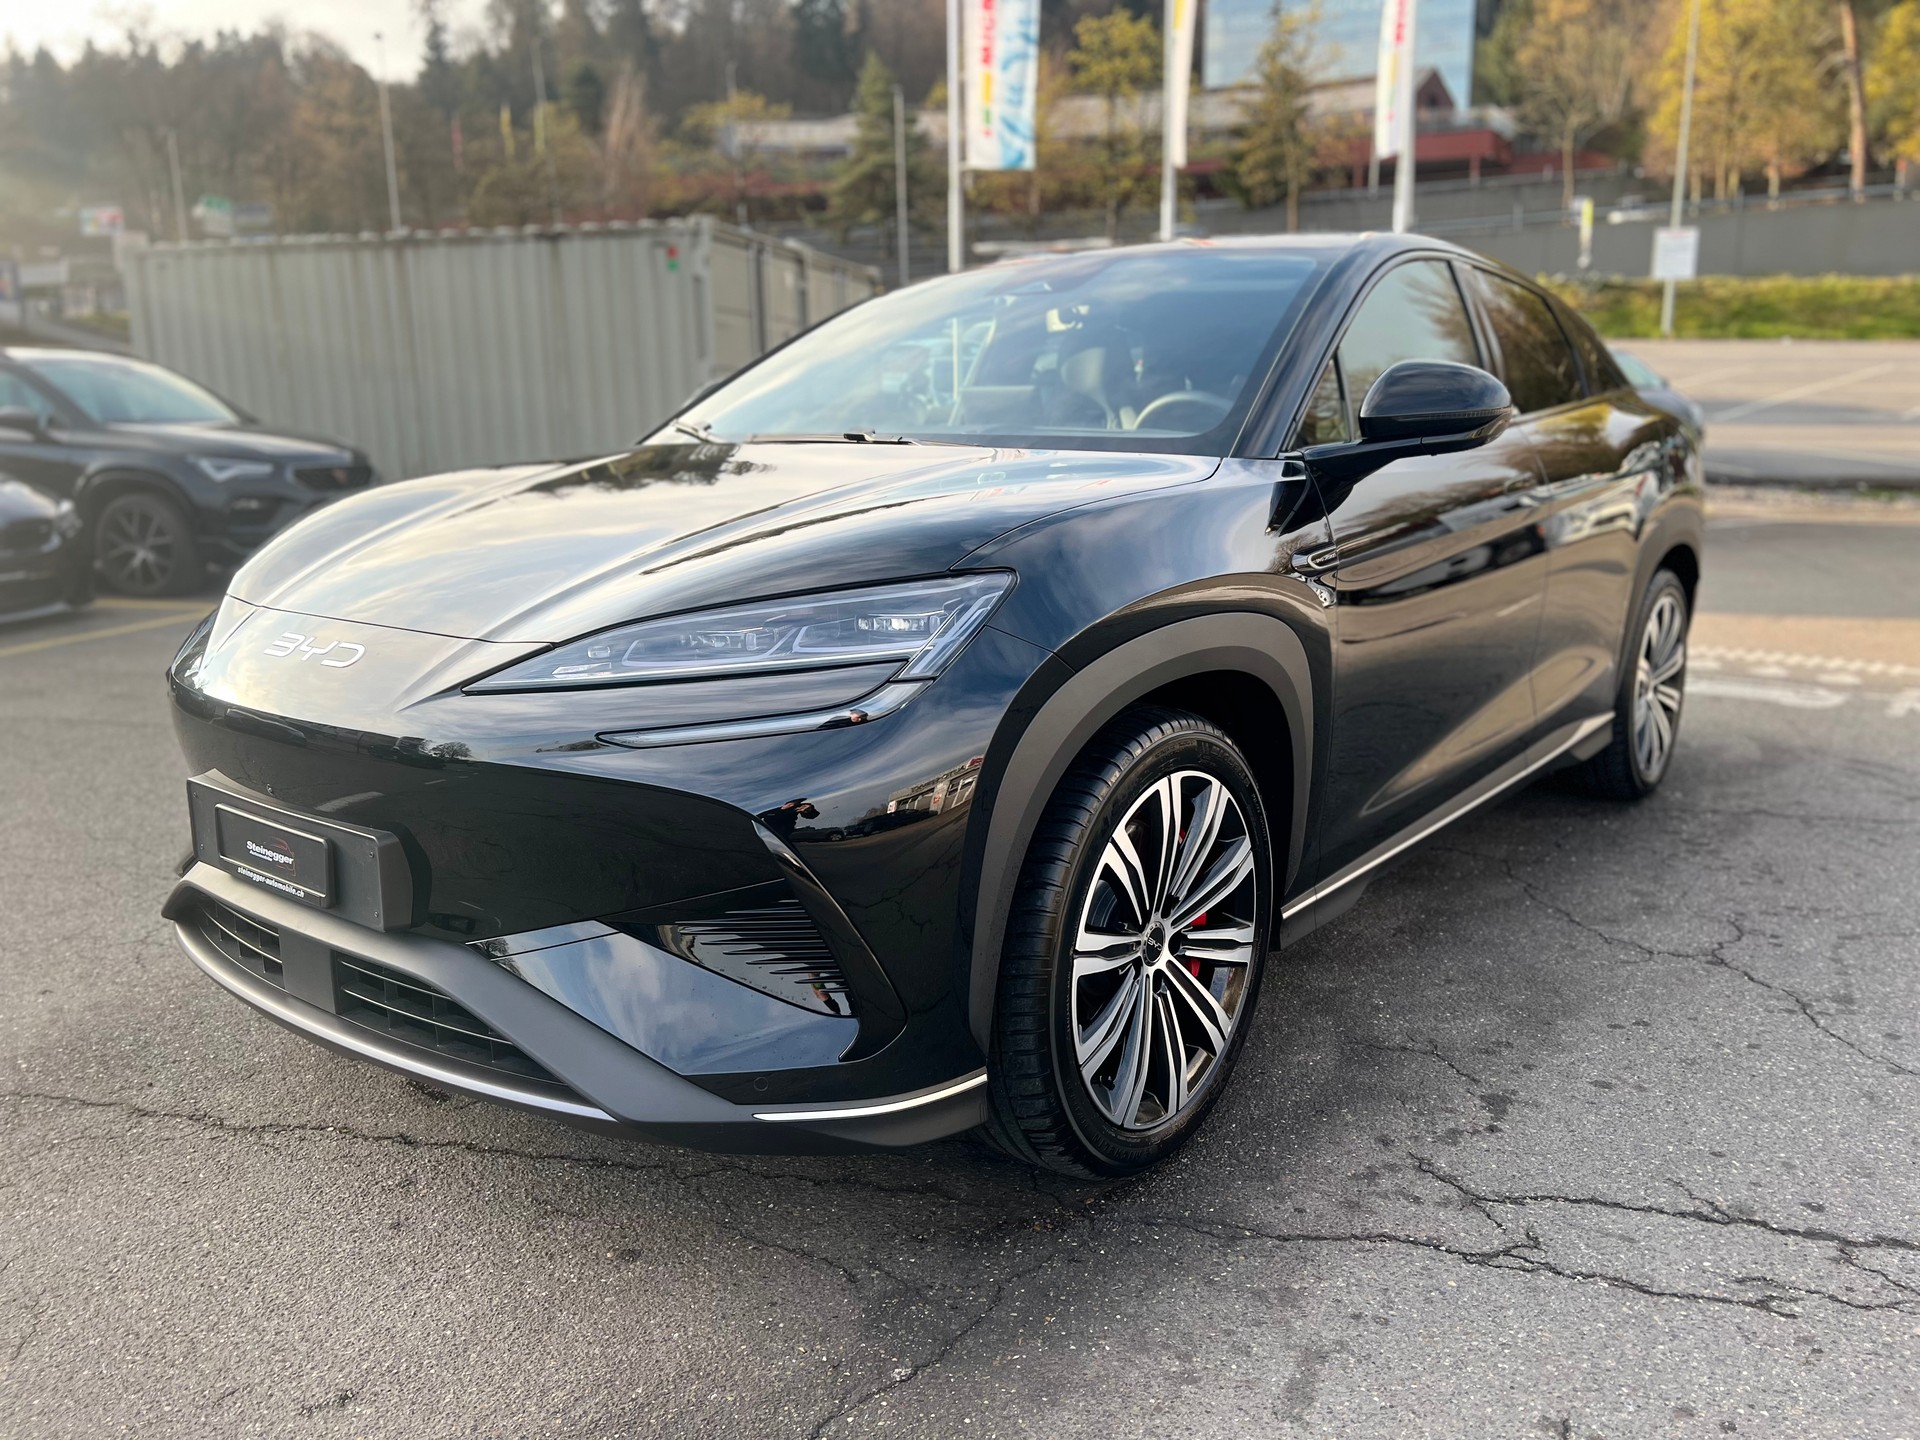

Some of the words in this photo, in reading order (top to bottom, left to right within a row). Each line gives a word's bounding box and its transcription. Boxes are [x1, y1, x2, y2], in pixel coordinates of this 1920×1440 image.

[263, 631, 366, 668] BYD
[246, 840, 294, 864] Steinegger
[237, 867, 305, 898] steinegger-automobile.ch
[1147, 937, 1163, 951] BYD
